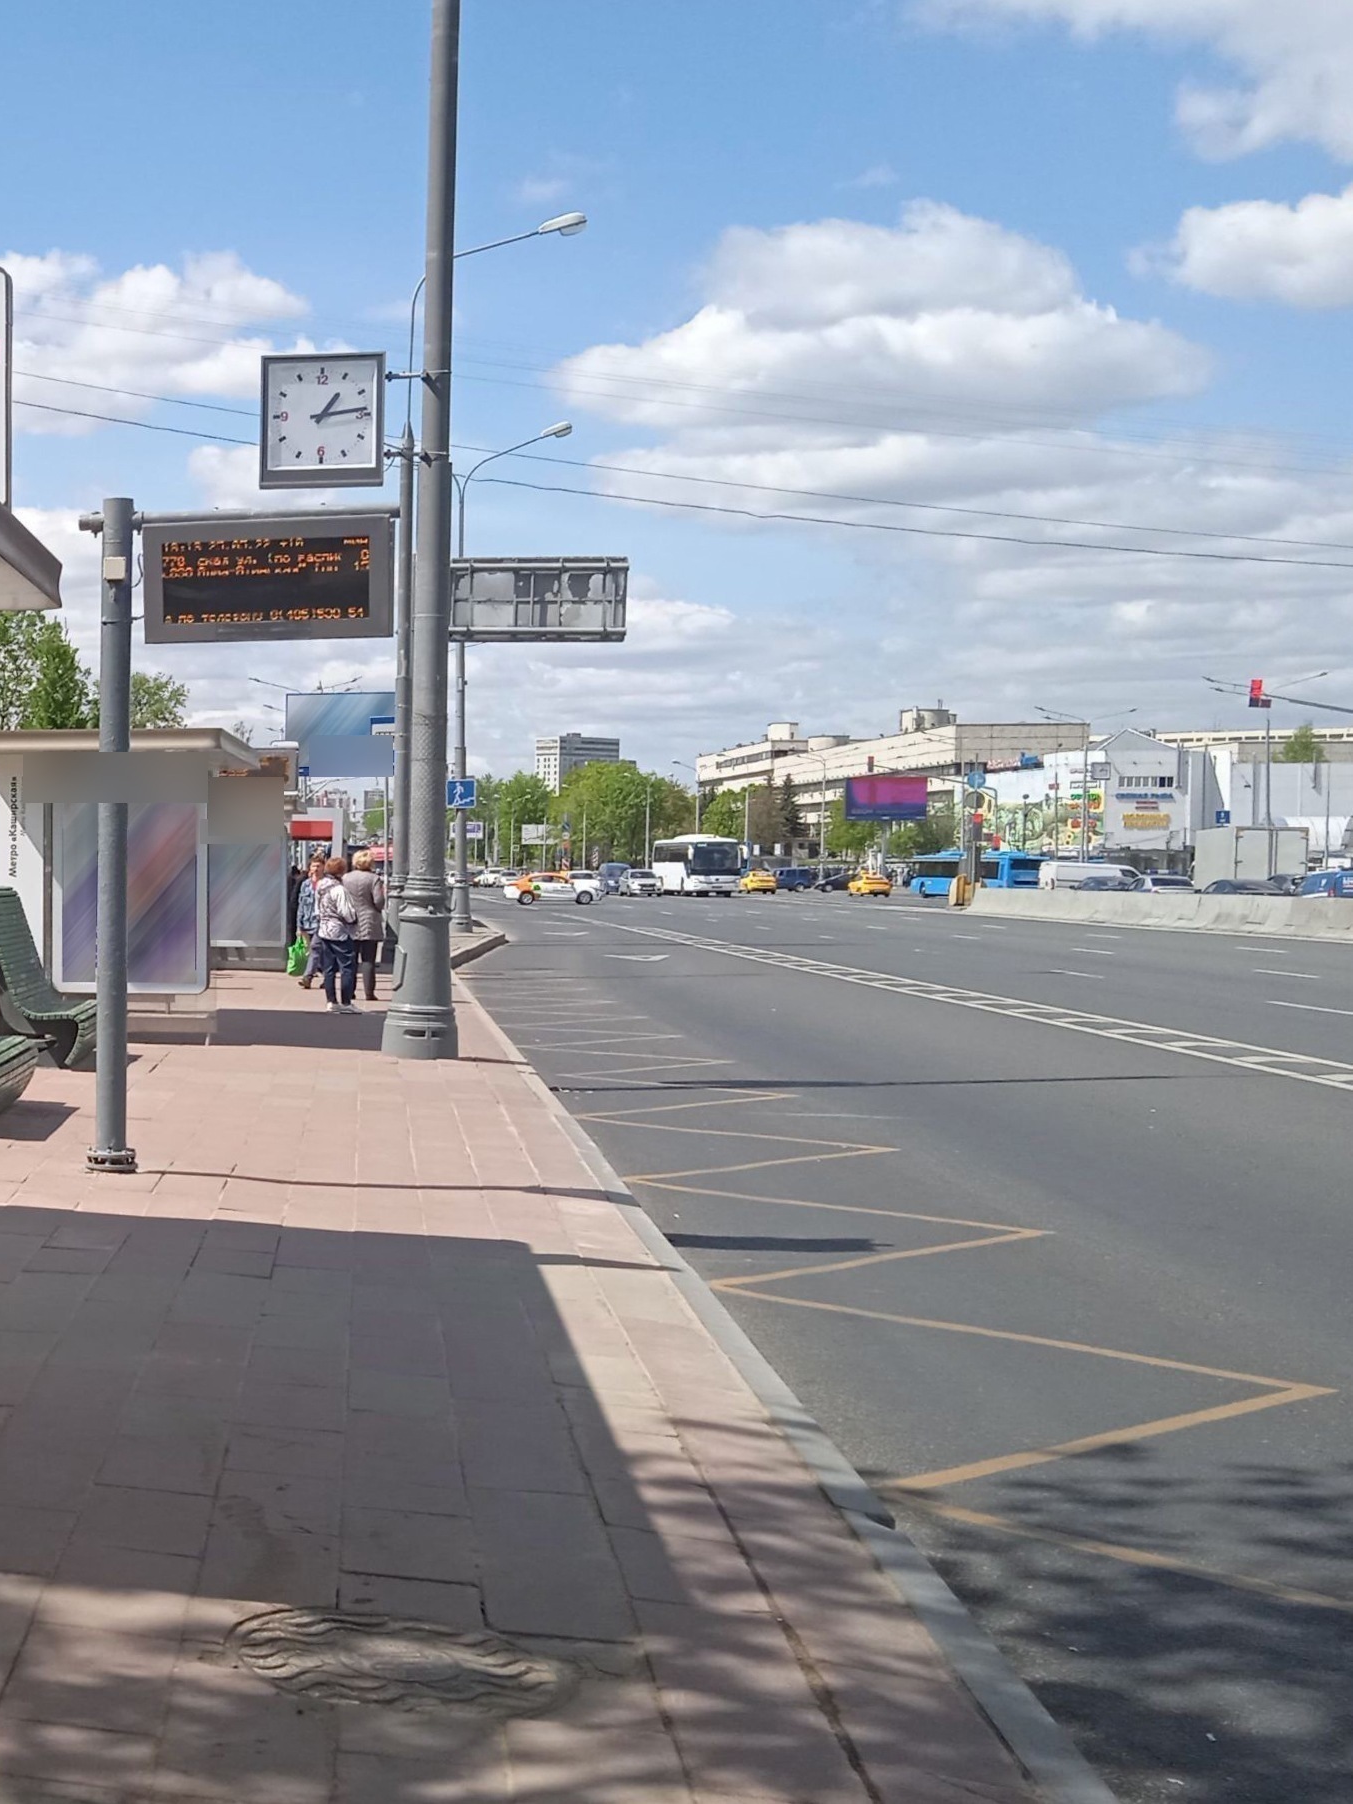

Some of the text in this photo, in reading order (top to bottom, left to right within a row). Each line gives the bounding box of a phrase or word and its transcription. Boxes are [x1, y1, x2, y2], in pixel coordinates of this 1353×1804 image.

[316, 375, 329, 386] 12
[280, 411, 289, 422] 9
[355, 410, 364, 420] 3
[317, 446, 325, 457] 6
[9, 844, 19, 877] Метро
